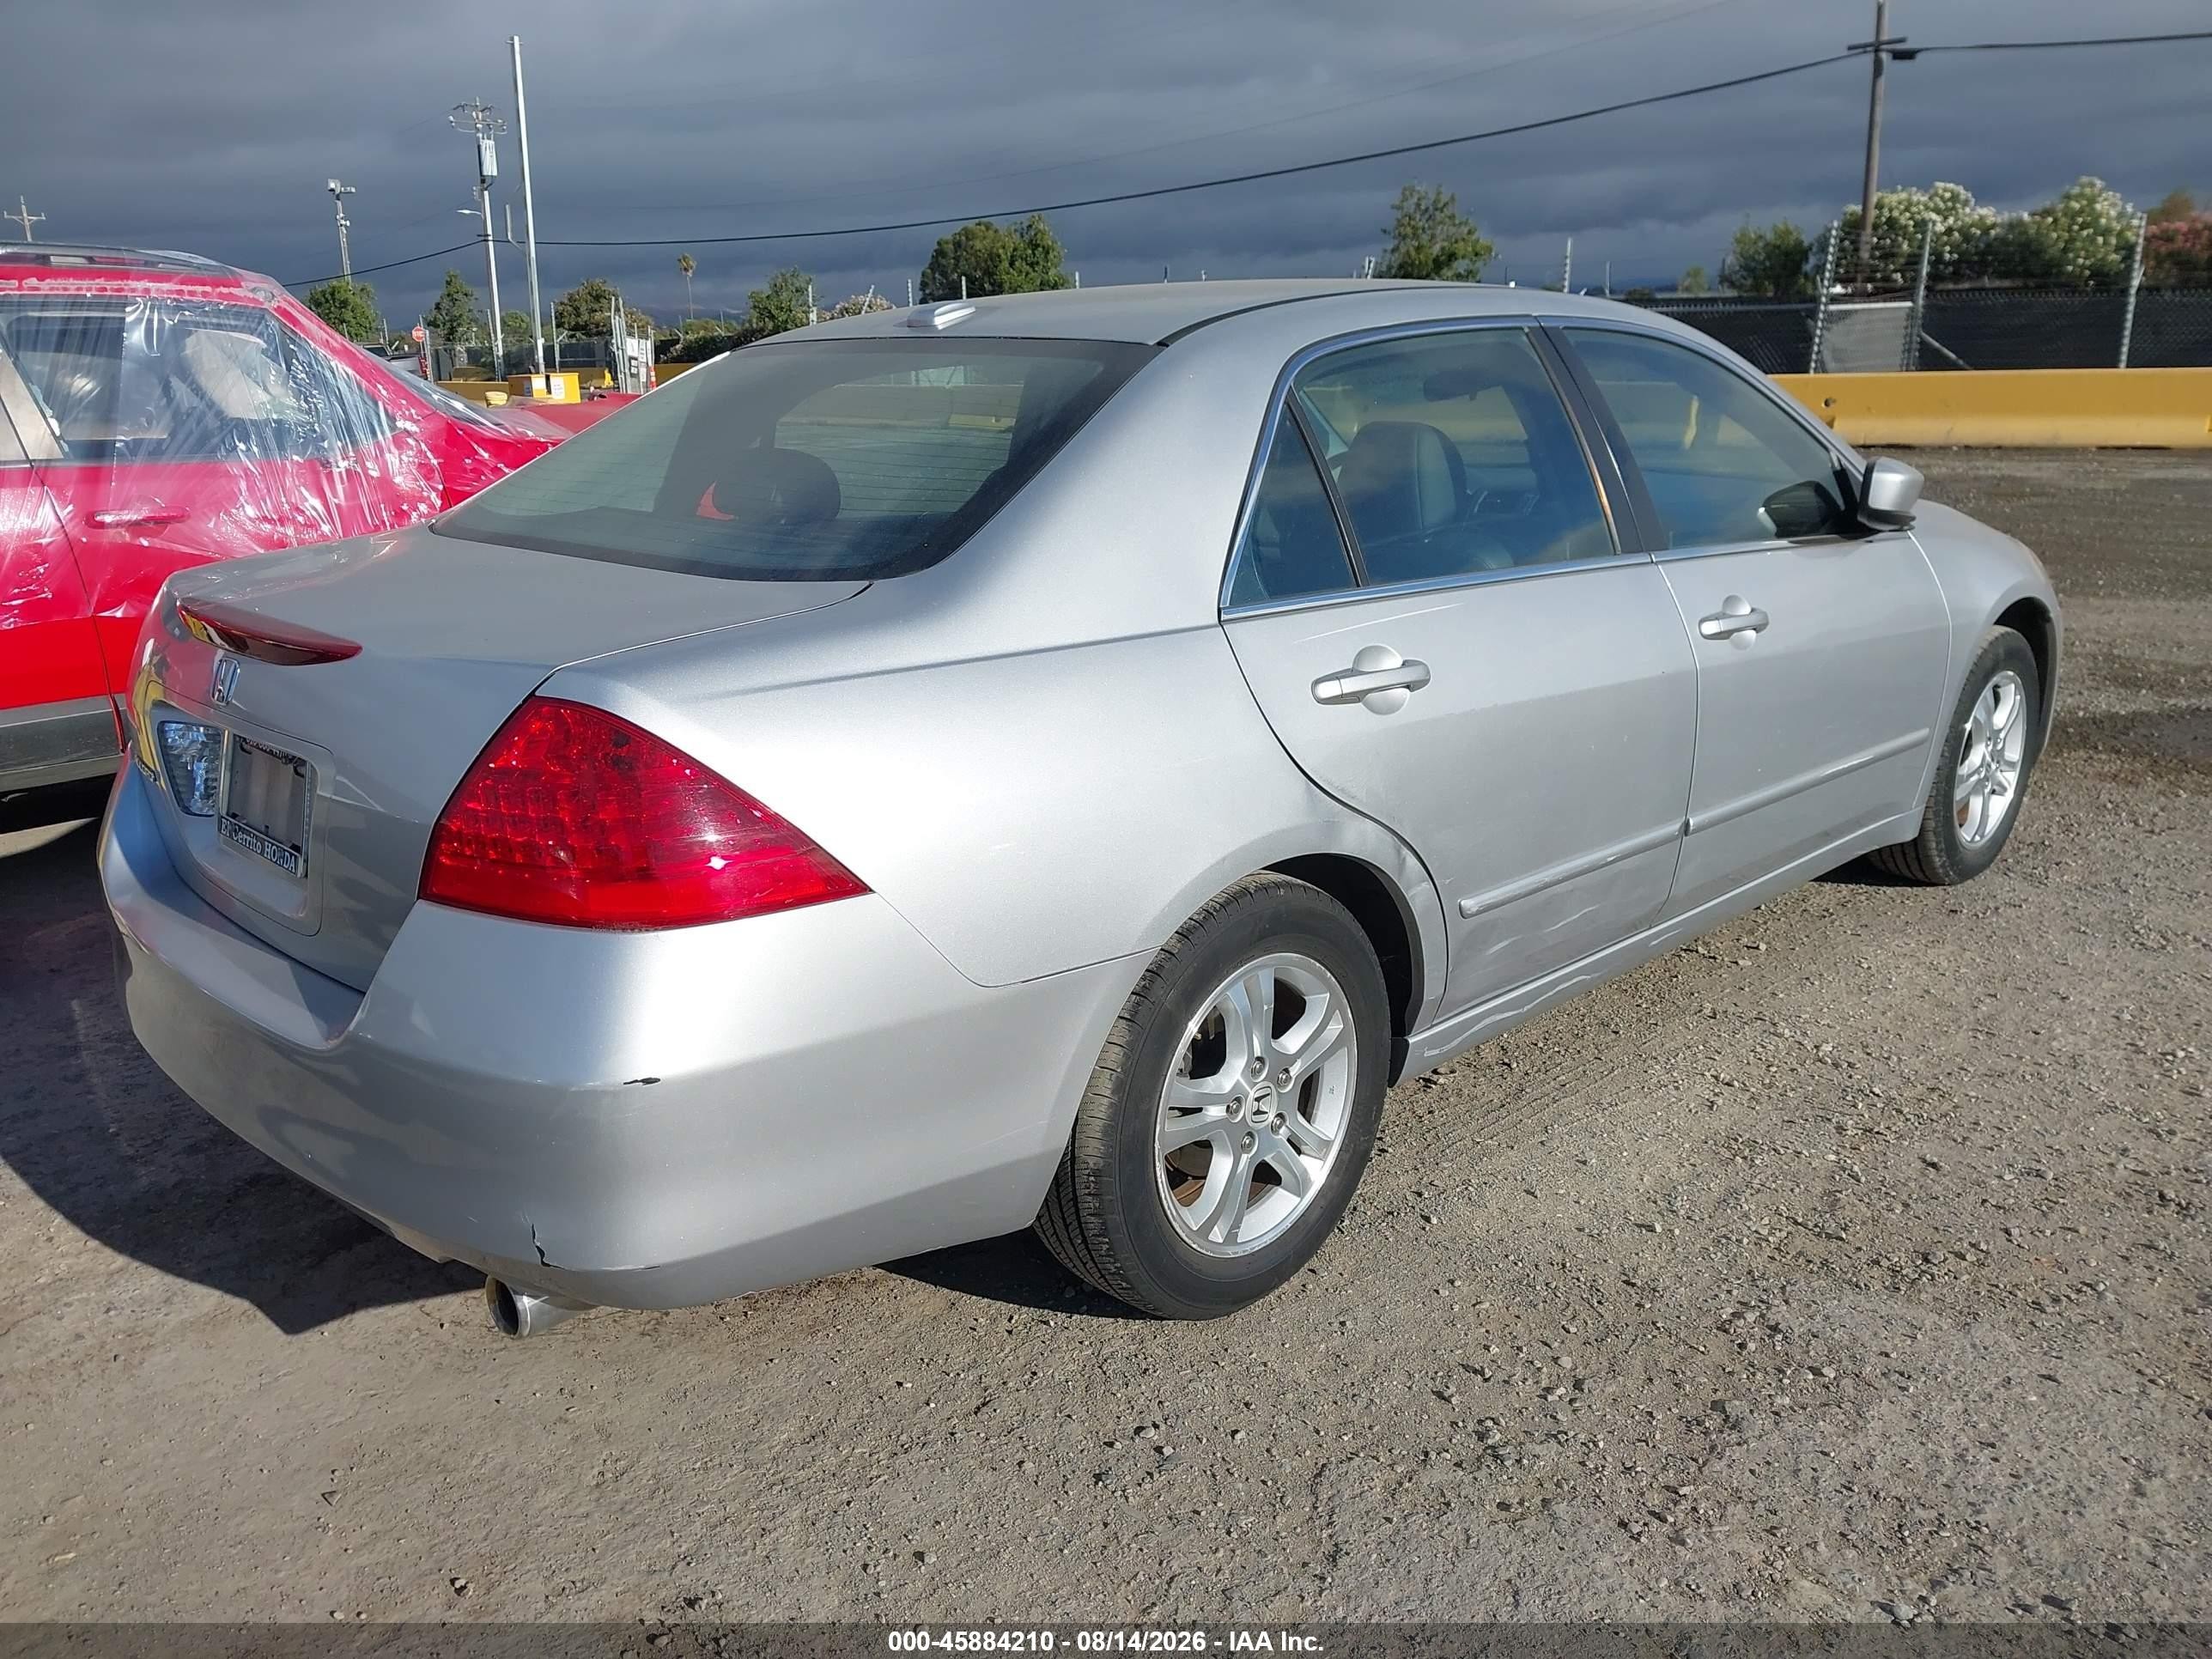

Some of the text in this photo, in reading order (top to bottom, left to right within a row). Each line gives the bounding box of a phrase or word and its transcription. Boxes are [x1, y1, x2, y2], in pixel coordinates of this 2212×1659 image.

[221, 818, 295, 872] El Cerrito HONDA
